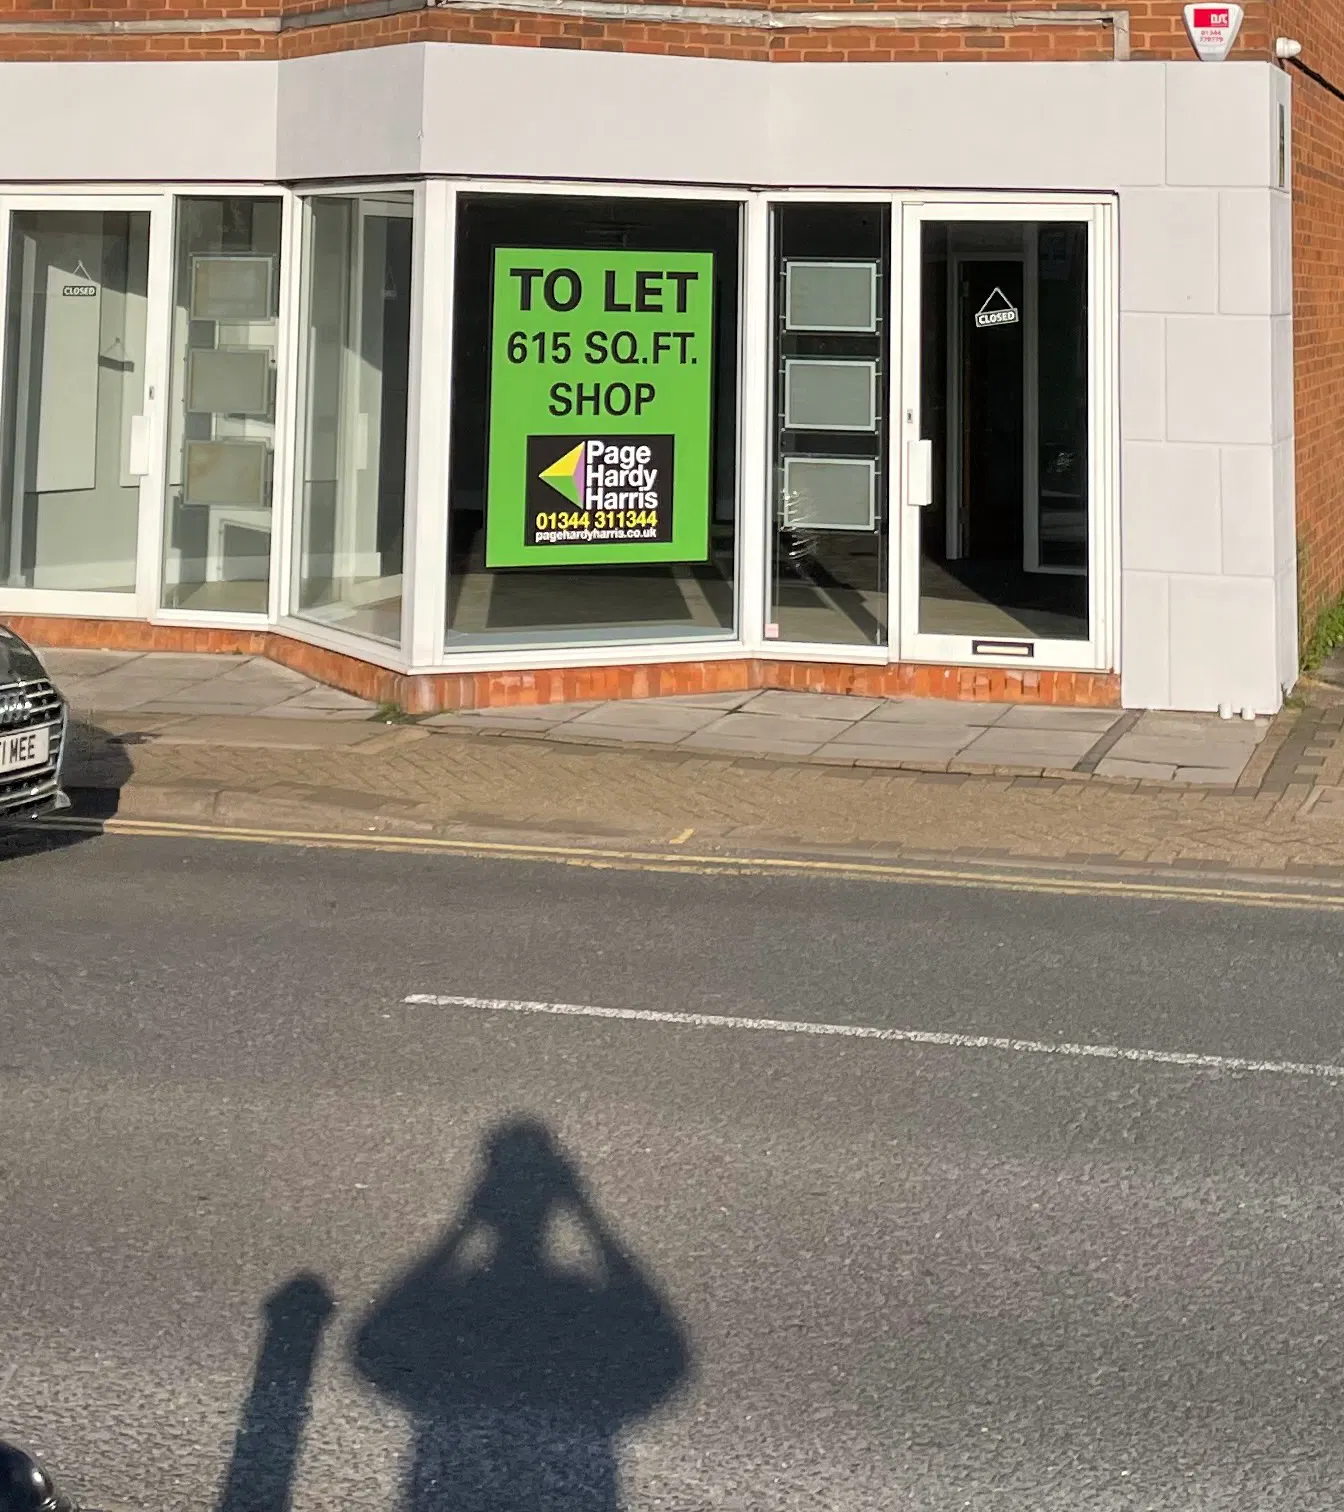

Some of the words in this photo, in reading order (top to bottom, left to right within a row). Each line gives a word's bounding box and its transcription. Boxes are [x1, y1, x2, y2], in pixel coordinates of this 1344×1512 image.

[64, 286, 95, 296] CLOSED
[510, 268, 582, 312] TO
[604, 270, 699, 313] LET
[978, 311, 1015, 325] CLOSED
[507, 330, 572, 364] 615
[584, 330, 697, 364] SQ.FT.
[548, 382, 656, 416] SHOP
[585, 440, 651, 470] Page
[585, 464, 658, 491] Hardy
[585, 487, 658, 510] Harris
[535, 511, 591, 530] 01344
[594, 510, 658, 529] 311344
[535, 527, 657, 543] pagehardyharris.co.uk
[8, 734, 37, 764] MEE
